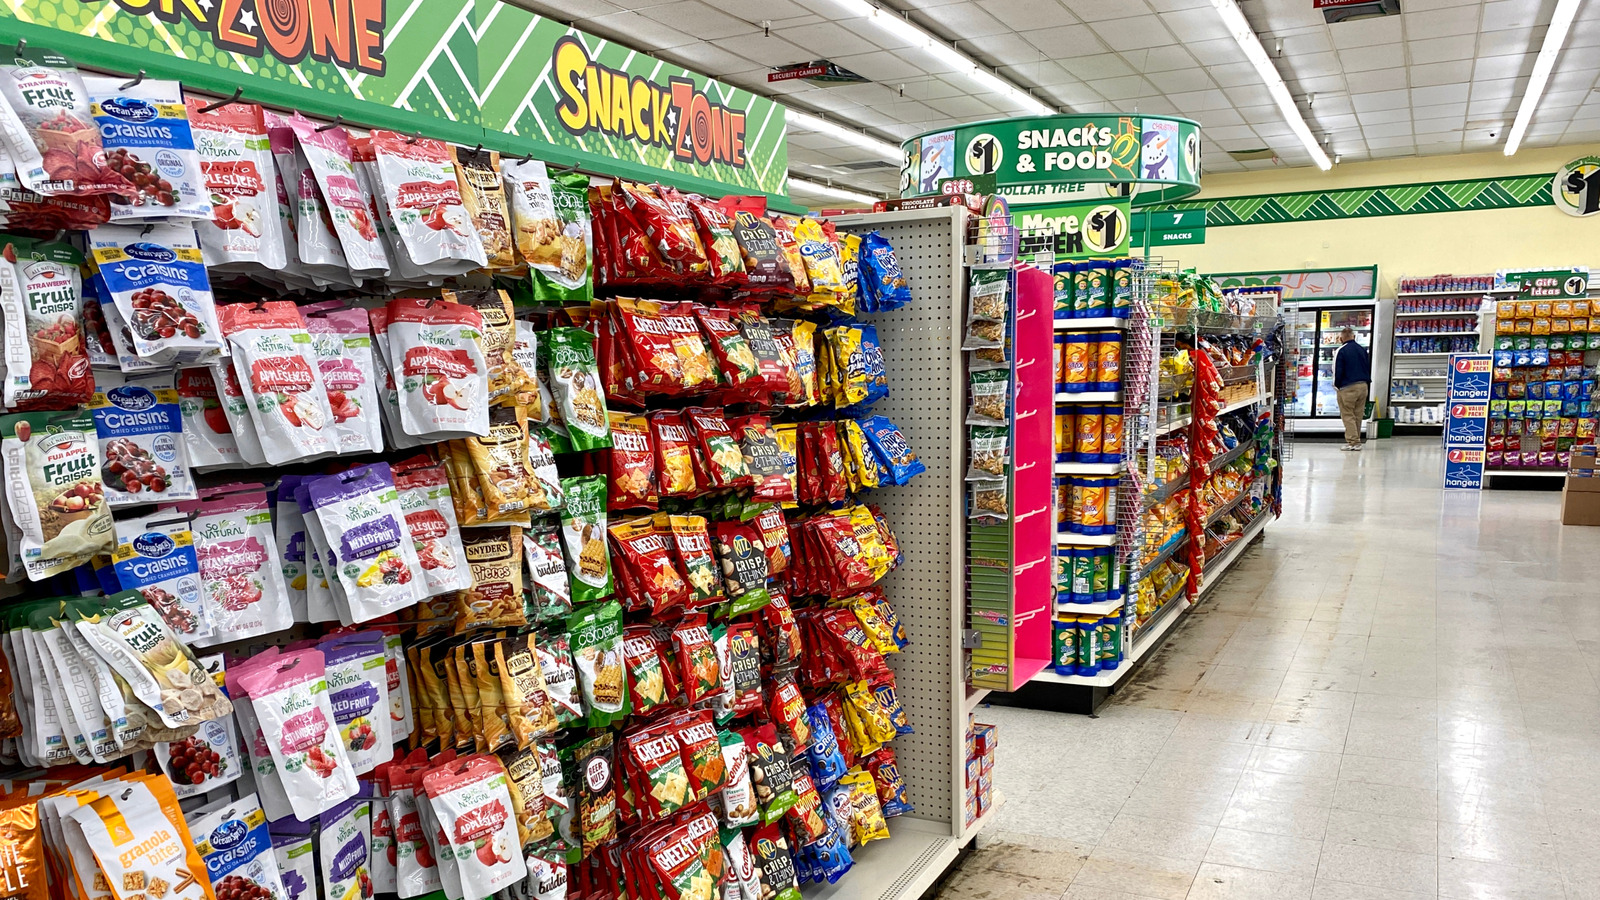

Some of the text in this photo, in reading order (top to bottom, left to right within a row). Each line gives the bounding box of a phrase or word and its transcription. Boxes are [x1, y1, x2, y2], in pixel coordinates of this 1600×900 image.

[772, 68, 822, 80] SECURITY CAMERA
[18, 80, 68, 88] STRAWBERRY
[22, 86, 76, 106] Fruit
[556, 41, 745, 165] SNACK ZONE
[38, 99, 74, 110] CRISPS
[101, 123, 172, 139] Craisins
[1017, 127, 1112, 149] SNACKS
[129, 138, 173, 147] CRANBERRIES
[201, 137, 213, 147] So
[928, 134, 954, 144] CHRISTMAS
[157, 159, 183, 167] ORIGINAL
[972, 137, 995, 175] $1
[1016, 151, 1112, 173] & FOOD
[942, 181, 973, 195] Gift
[996, 182, 1085, 195] DOLLAR TREE
[1022, 213, 1078, 236] More
[1173, 213, 1184, 225] 7
[1087, 209, 1118, 250] $1
[1163, 232, 1192, 241] SNACKS
[1019, 230, 1083, 253] OWER
[124, 265, 188, 281] Craisins
[27, 279, 72, 290] STRAWBERRY
[133, 277, 153, 287] DRIED
[1535, 278, 1557, 287] Gift
[1567, 279, 1582, 294] $1
[1531, 287, 1560, 295] Ideas
[28, 287, 76, 311] Fruit
[40, 302, 74, 315] CRISPS
[632, 316, 668, 335] CHEEZ-IT
[745, 329, 771, 340] CRISP
[1461, 361, 1467, 369] 7
[1454, 390, 1488, 398] hangers
[1456, 406, 1462, 414] 7
[105, 410, 169, 429] Craisins
[694, 416, 730, 432] CHEEZ-IT
[132, 425, 170, 433] CRANBERRIES
[659, 424, 689, 442] CHEEZ-IT
[612, 431, 649, 451] CHEEZ-IT
[1450, 435, 1483, 443] hangers
[48, 447, 87, 462] FUJI APPLE
[155, 444, 175, 452] ORIGINAL
[751, 445, 776, 456] CRISP
[1453, 451, 1459, 459] 7
[43, 454, 96, 482] Fruit
[54, 469, 92, 486] CRISPS
[1446, 479, 1479, 488] hangers
[349, 506, 357, 514] So
[200, 526, 244, 539] NATURAL
[206, 523, 217, 532] So
[137, 541, 154, 552] Ocean
[349, 529, 395, 550] MIXED FRUIT
[629, 535, 663, 554] CHEEZ-IT
[678, 535, 709, 551] CHEEZ-IT
[733, 538, 751, 555] RITZ
[469, 543, 508, 555] SNYDER'S
[133, 553, 189, 579] Craisins
[536, 561, 566, 577] buddies
[736, 558, 762, 572] CRISP
[141, 567, 189, 583] DRIED CRANBERRIES
[471, 565, 510, 582] Pieces
[179, 585, 198, 595] ORIGINAL
[123, 621, 144, 636] BANANA
[126, 623, 162, 650] Fruit
[137, 634, 165, 654] CRISPS
[732, 637, 749, 657] RITZ
[733, 658, 756, 672] CRISP
[328, 673, 362, 688] NATURAL
[333, 672, 343, 680] So
[350, 696, 371, 711] FRUIT
[875, 687, 898, 708] RITZ
[679, 722, 718, 745] CHEEZ-IT
[636, 736, 680, 762] CHEEZ-IT
[588, 762, 603, 775] BEER
[765, 759, 786, 777] CRISP
[880, 764, 900, 783] RITZ
[591, 771, 604, 786] NUTS
[853, 793, 878, 810] Sandies
[460, 820, 483, 835] APPLE
[212, 835, 232, 845] Ocean
[118, 829, 171, 868] granola
[146, 841, 180, 866] bites
[208, 836, 257, 872] Craisins
[656, 837, 698, 871] CHEEZ-IT
[758, 840, 776, 859] RITZ
[339, 845, 365, 871] MIXED FRUIT
[764, 855, 789, 875] CRISP
